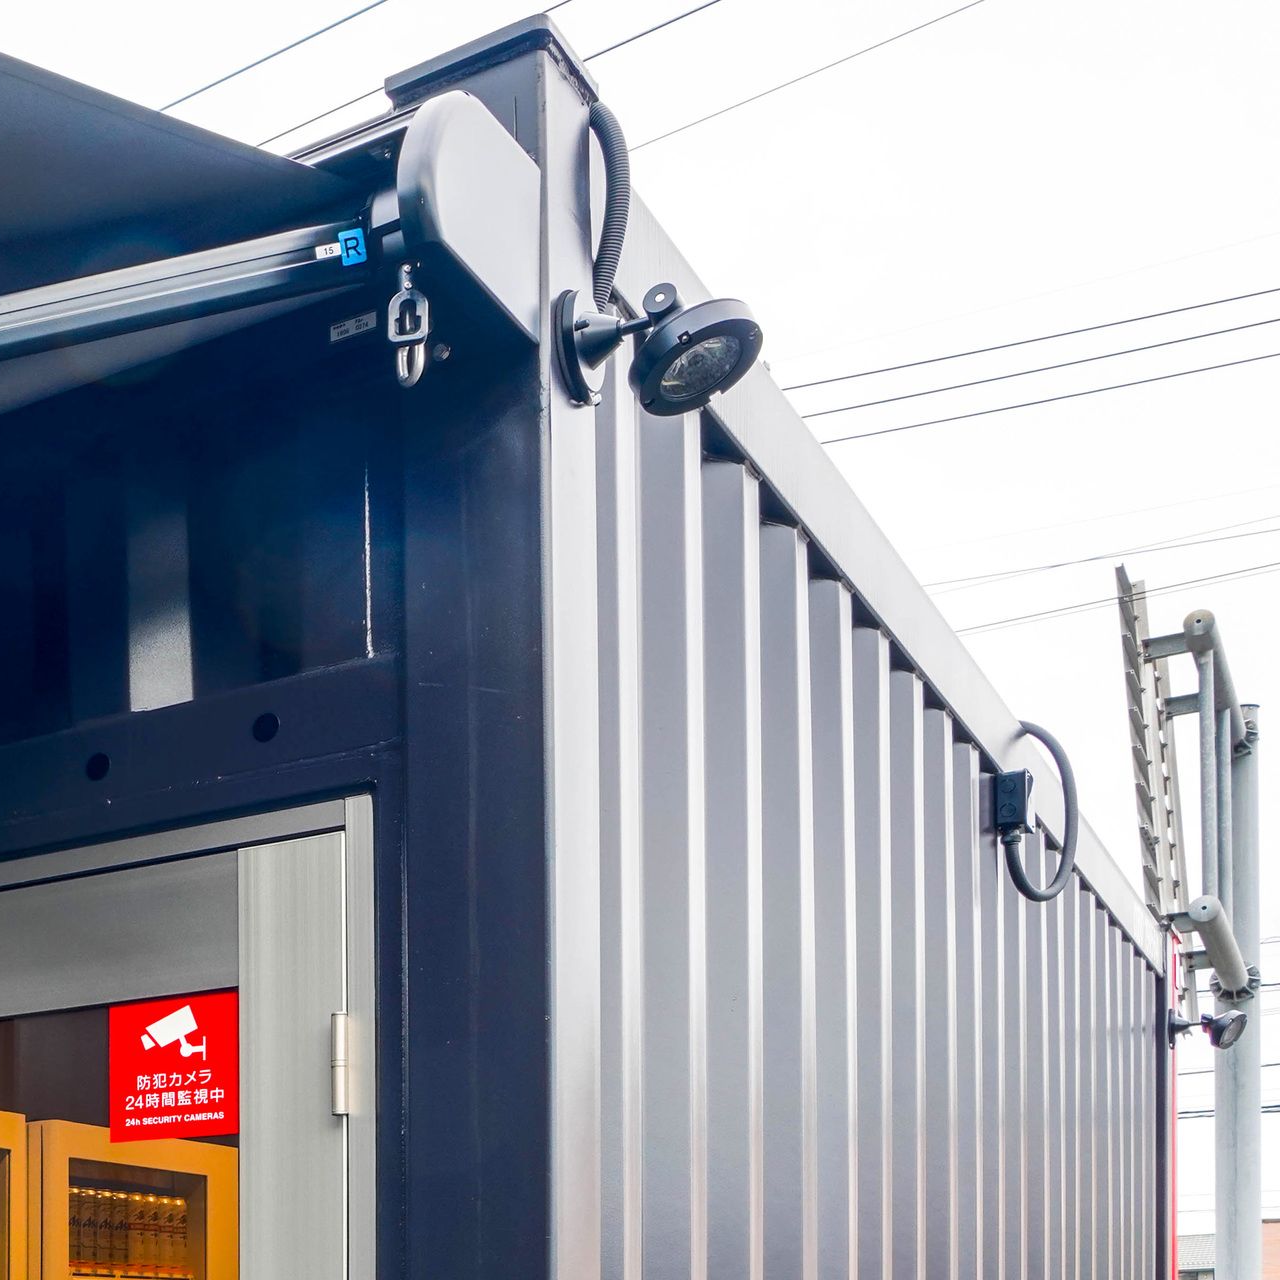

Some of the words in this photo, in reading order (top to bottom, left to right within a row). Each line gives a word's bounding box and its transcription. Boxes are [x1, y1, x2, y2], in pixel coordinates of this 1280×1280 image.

[324, 247, 334, 256] 15
[344, 236, 362, 258] R
[136, 1069, 213, 1091] 防犯カメラ
[125, 1088, 225, 1111] 24時間監視中
[125, 1118, 141, 1127] 24h
[142, 1114, 182, 1126] SECURITY
[184, 1111, 225, 1122] CAMERAS
